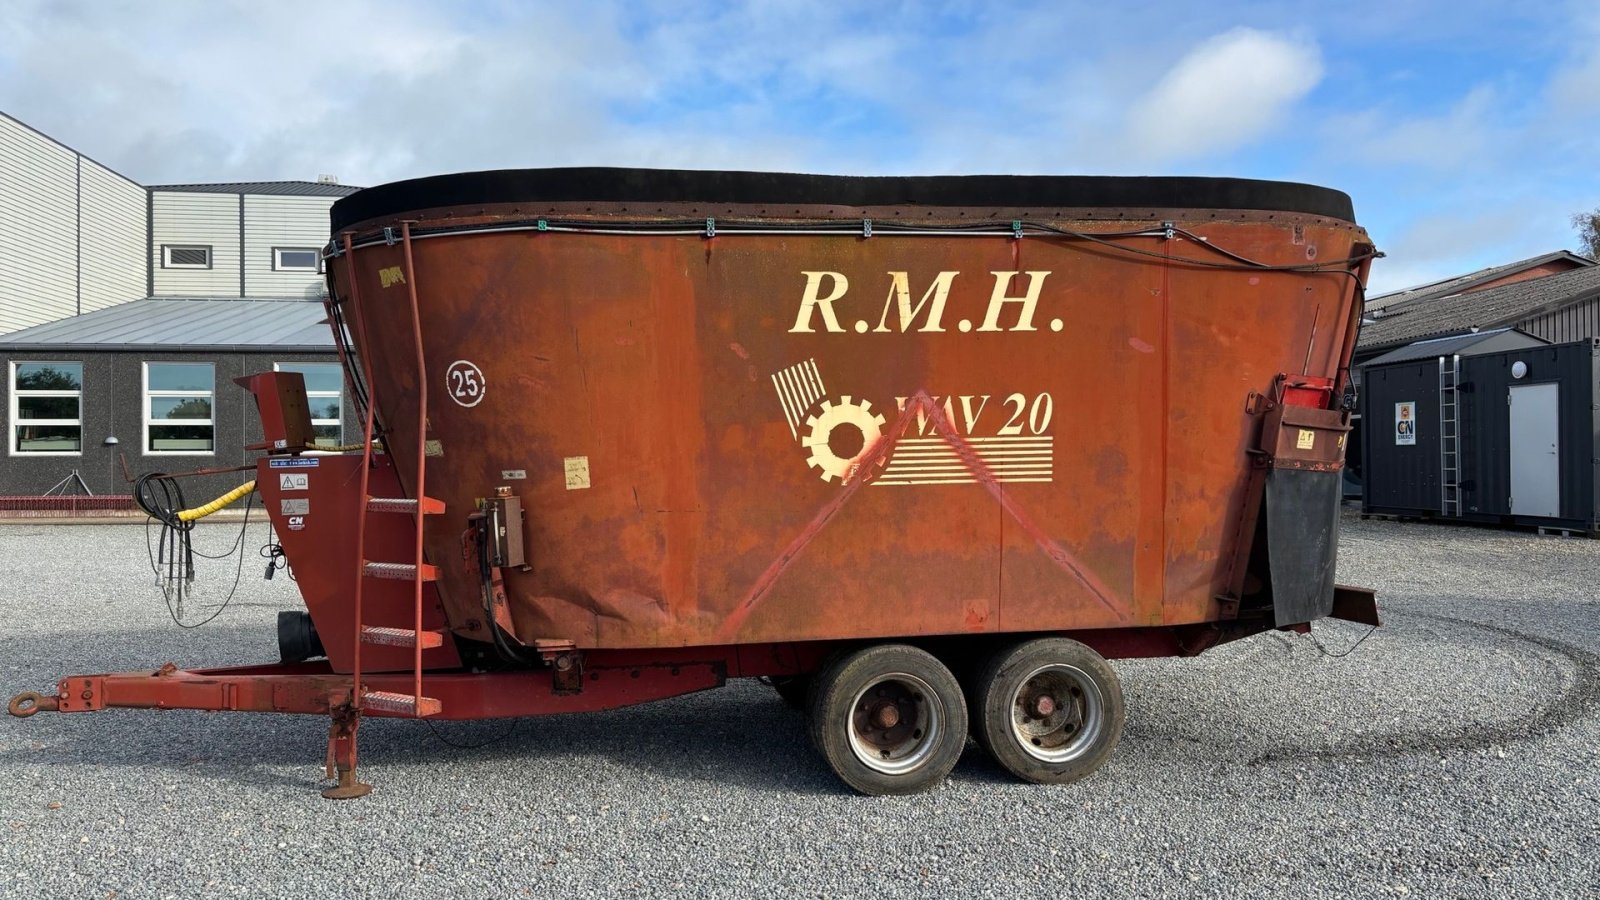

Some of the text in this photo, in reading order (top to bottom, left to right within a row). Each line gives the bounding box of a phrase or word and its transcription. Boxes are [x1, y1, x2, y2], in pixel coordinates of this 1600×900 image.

[788, 271, 1064, 333] R.M.H.
[452, 370, 479, 397] 25
[997, 392, 1053, 436] 20
[1397, 420, 1413, 434] CN
[288, 516, 303, 525] CN
